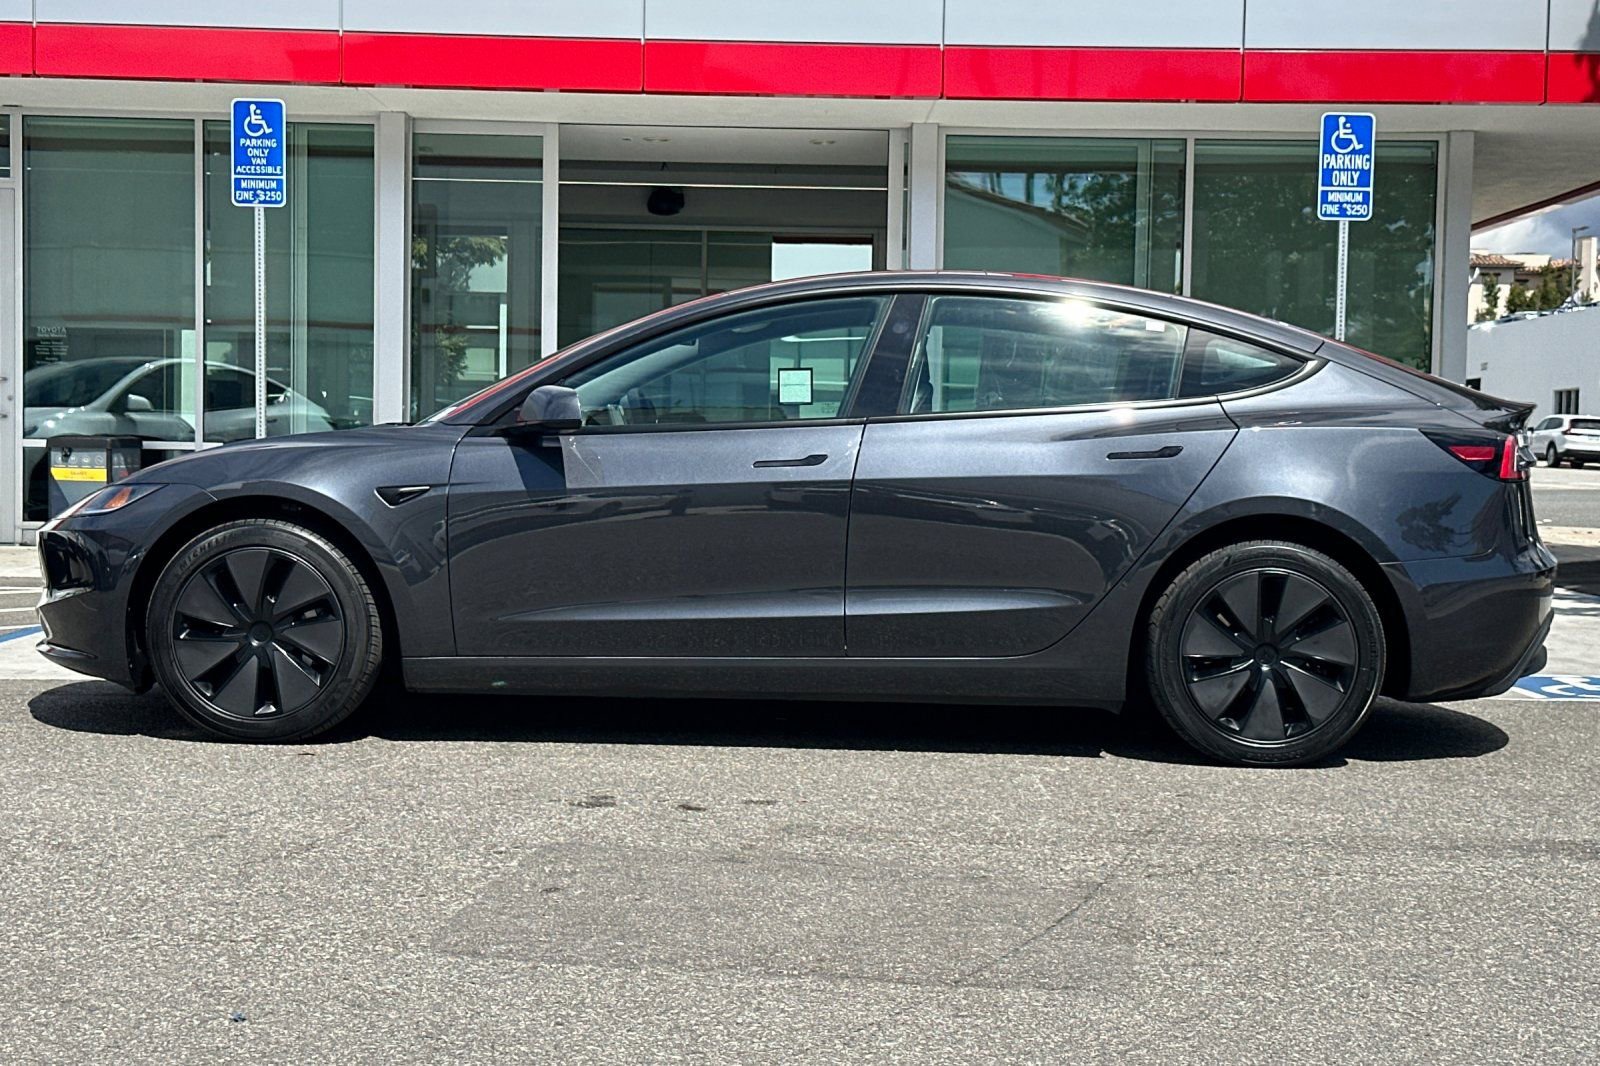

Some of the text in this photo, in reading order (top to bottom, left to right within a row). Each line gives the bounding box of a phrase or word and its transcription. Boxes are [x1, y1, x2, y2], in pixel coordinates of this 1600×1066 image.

[239, 138, 277, 148] PARKING
[247, 148, 269, 157] ONLY
[251, 157, 267, 166] VAN
[1323, 154, 1370, 170] PARKING
[235, 165, 282, 175] ACCESSIBLE
[1332, 171, 1361, 186] ONLY
[240, 179, 277, 189] MINIMUM
[236, 191, 254, 201] FINE
[1327, 192, 1363, 203] MINIMUM
[1322, 204, 1368, 216] FINE $250
[36, 326, 67, 334] TOYOTA
